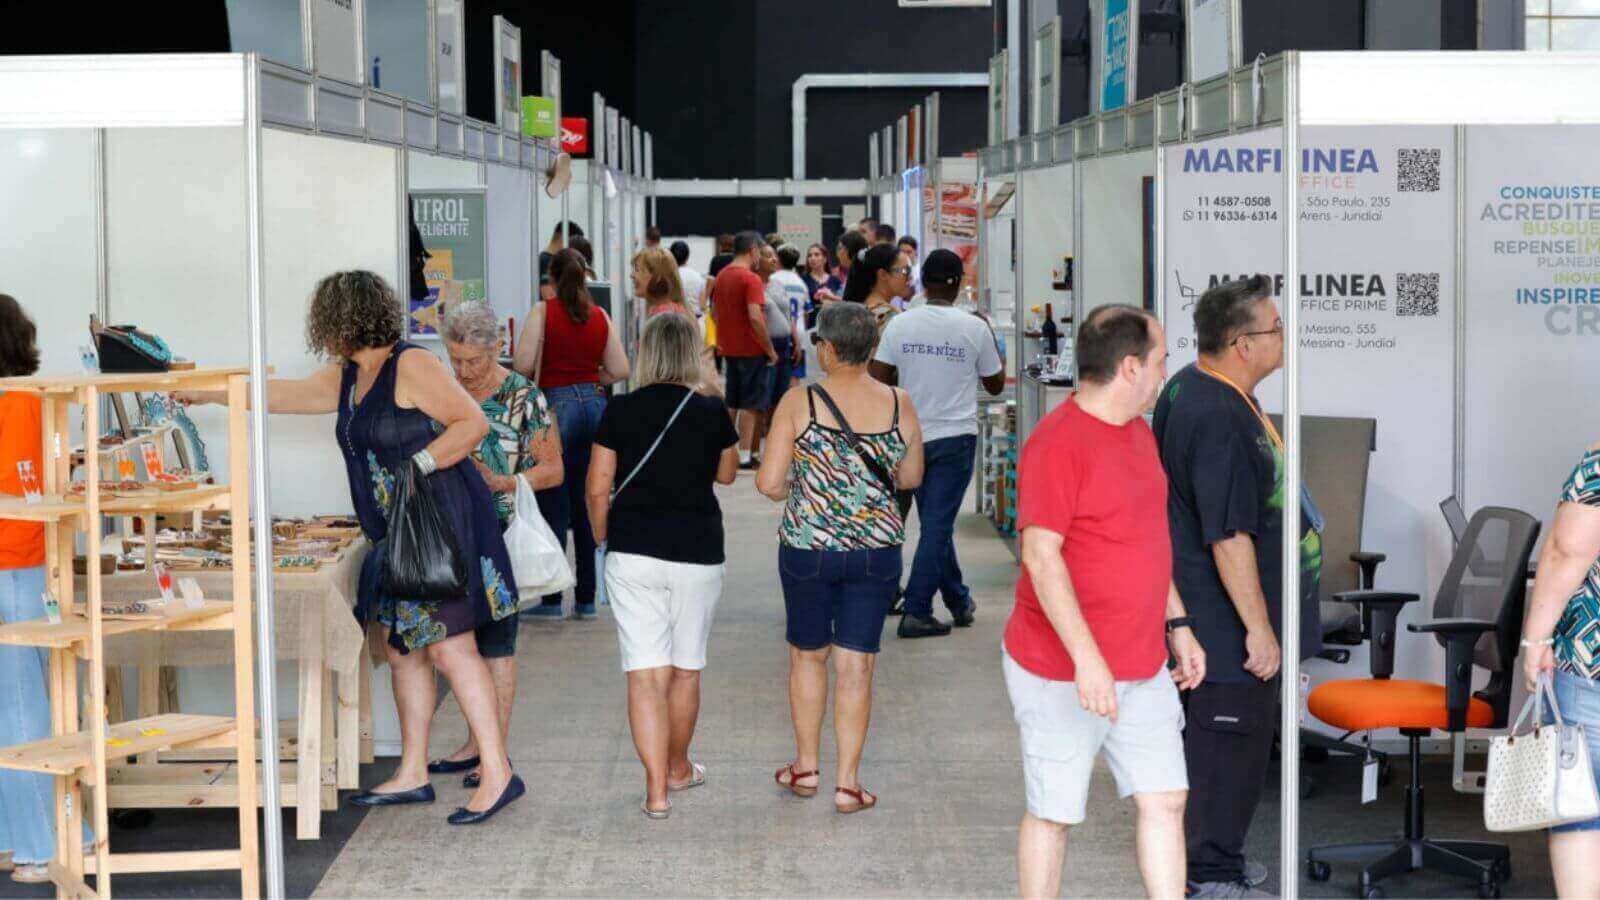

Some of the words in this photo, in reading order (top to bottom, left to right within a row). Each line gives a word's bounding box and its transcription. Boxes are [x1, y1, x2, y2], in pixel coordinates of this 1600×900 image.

[1500, 186, 1600, 200] CONQUISTE
[1198, 196, 1209, 206] 11
[1213, 196, 1271, 206] 4587-0508
[1370, 197, 1391, 207] 235
[1198, 211, 1209, 221] 11
[1213, 211, 1278, 221] 96336-6314
[1480, 203, 1600, 221] ACREDITE
[1523, 221, 1600, 236] BUSQUE
[1494, 240, 1577, 254] REPENSE
[1516, 288, 1600, 304] INSPIRE
[1344, 300, 1386, 311] PRIME
[1356, 323, 1377, 335] 555
